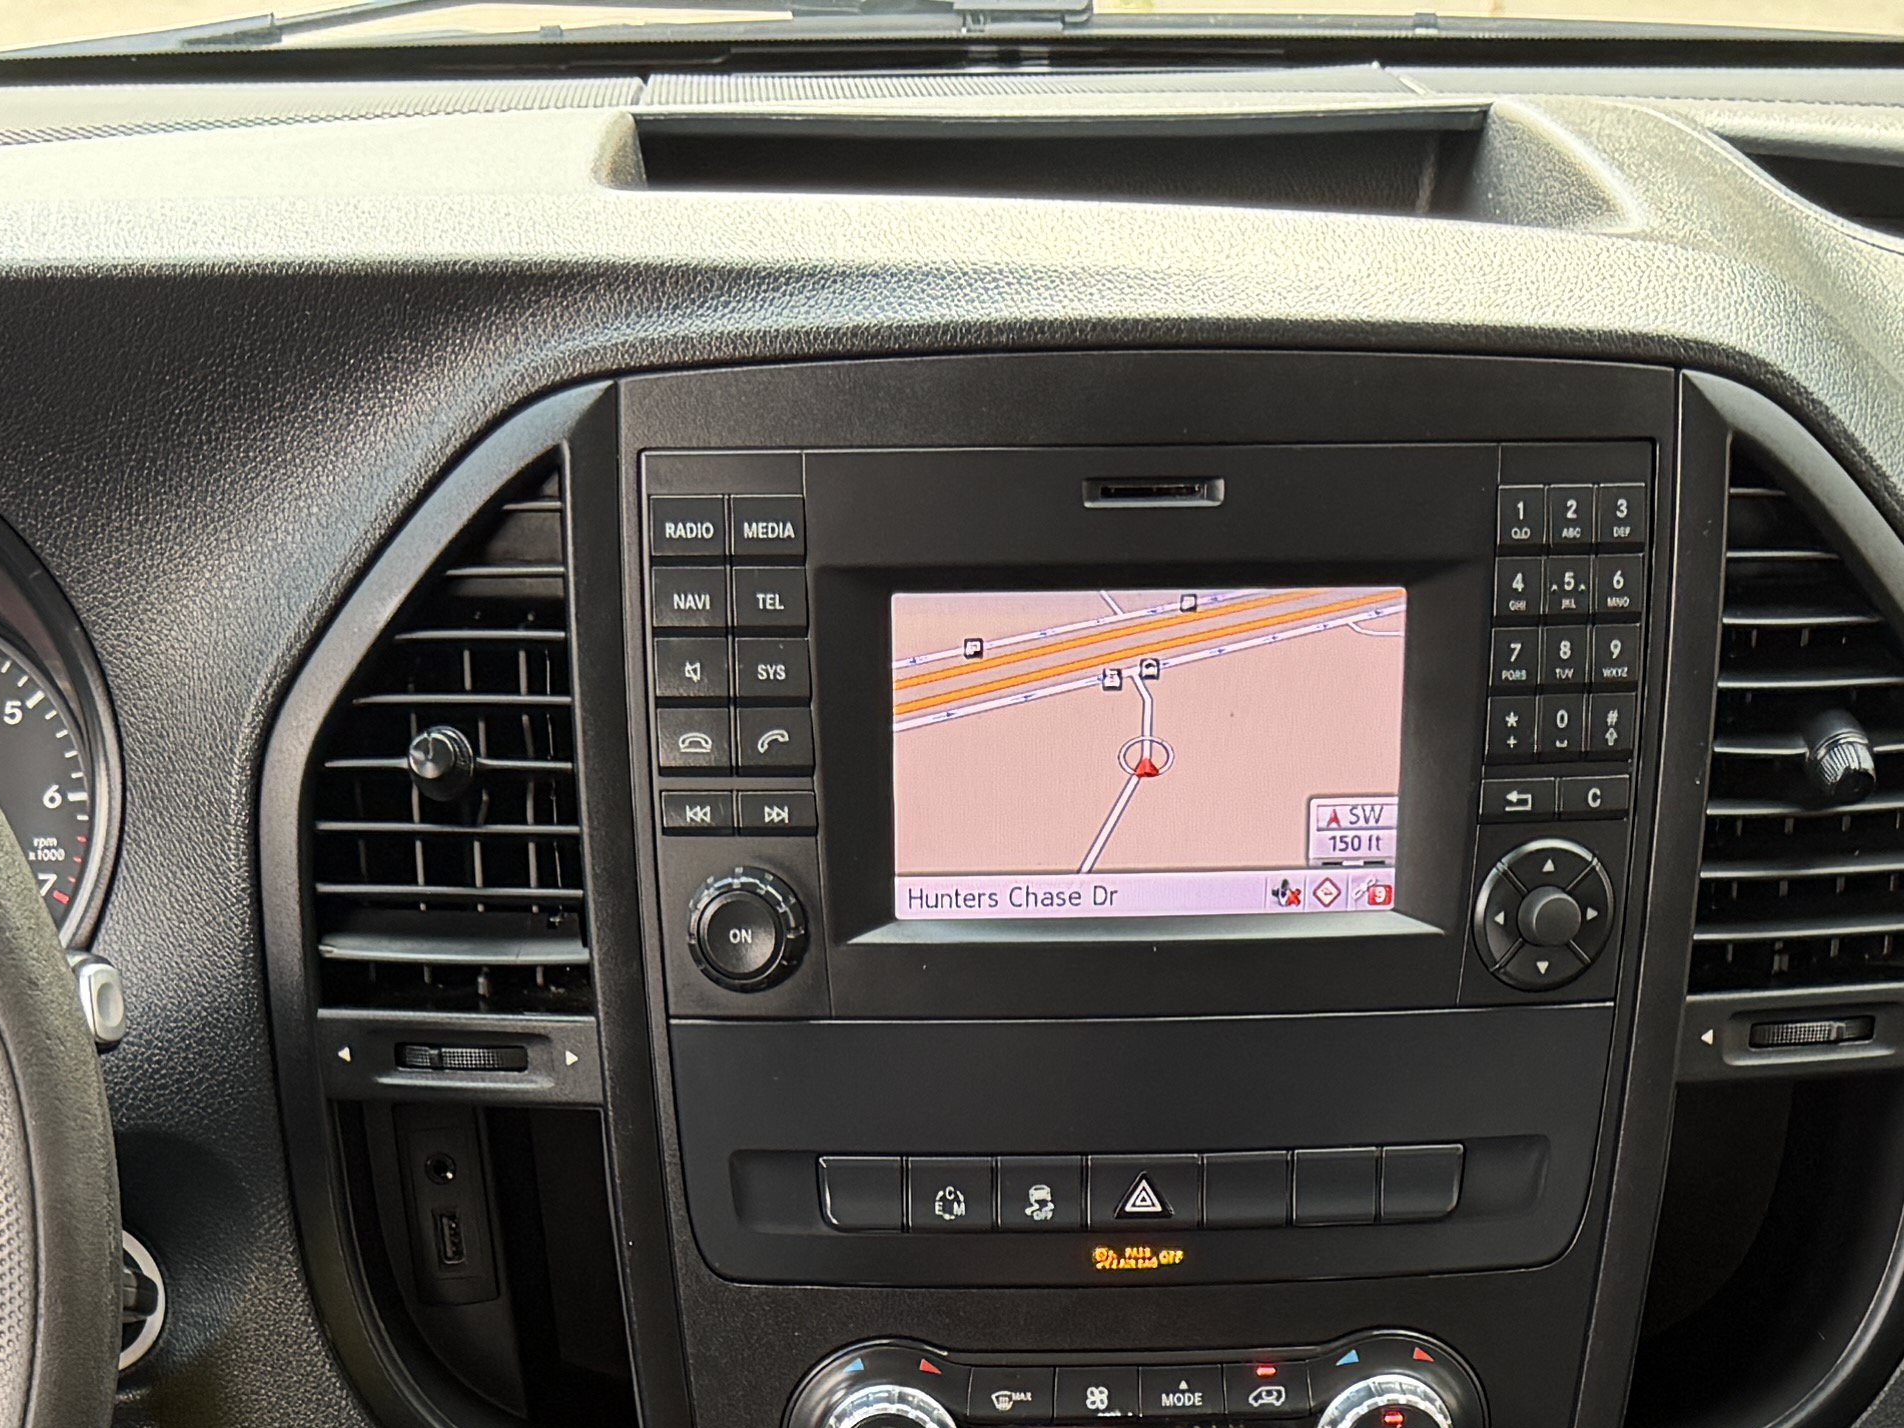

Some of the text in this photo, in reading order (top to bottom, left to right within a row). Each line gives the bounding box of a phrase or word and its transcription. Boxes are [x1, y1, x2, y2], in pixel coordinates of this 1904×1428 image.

[1516, 501, 1524, 520] 1
[1566, 499, 1577, 519] 2
[1616, 498, 1628, 518] 3
[665, 522, 714, 538] RADIO
[743, 522, 796, 539] MEDIA
[1562, 527, 1581, 538] ABC
[1613, 526, 1631, 537] DEF
[1512, 572, 1524, 592] 4
[1564, 571, 1575, 591] 5
[1612, 570, 1624, 590] 6
[673, 593, 710, 610] NAVI
[756, 593, 785, 610] TEL
[1607, 596, 1630, 607] MNO
[1510, 642, 1522, 662] 7
[1559, 640, 1571, 659] 8
[1610, 639, 1622, 659] 9
[757, 664, 786, 680] SYS
[1501, 669, 1527, 681] PQRS
[1555, 668, 1574, 679] TUV
[1602, 666, 1628, 678] WXYZ
[3, 701, 23, 725] 5
[1556, 709, 1568, 728] 0
[42, 784, 63, 808] 6
[1587, 787, 1601, 808] C
[1348, 806, 1384, 825] SW
[33, 837, 58, 849] rpm
[1328, 834, 1382, 852] 150 ft
[37, 873, 58, 897] 7
[908, 884, 1119, 910] Hunters Chase Dr
[1375, 886, 1387, 904] 9
[729, 928, 752, 944] ON
[946, 1186, 955, 1200] C
[935, 1201, 966, 1216] E M
[1012, 1391, 1032, 1401] MAX
[1161, 1392, 1203, 1407] MODE
